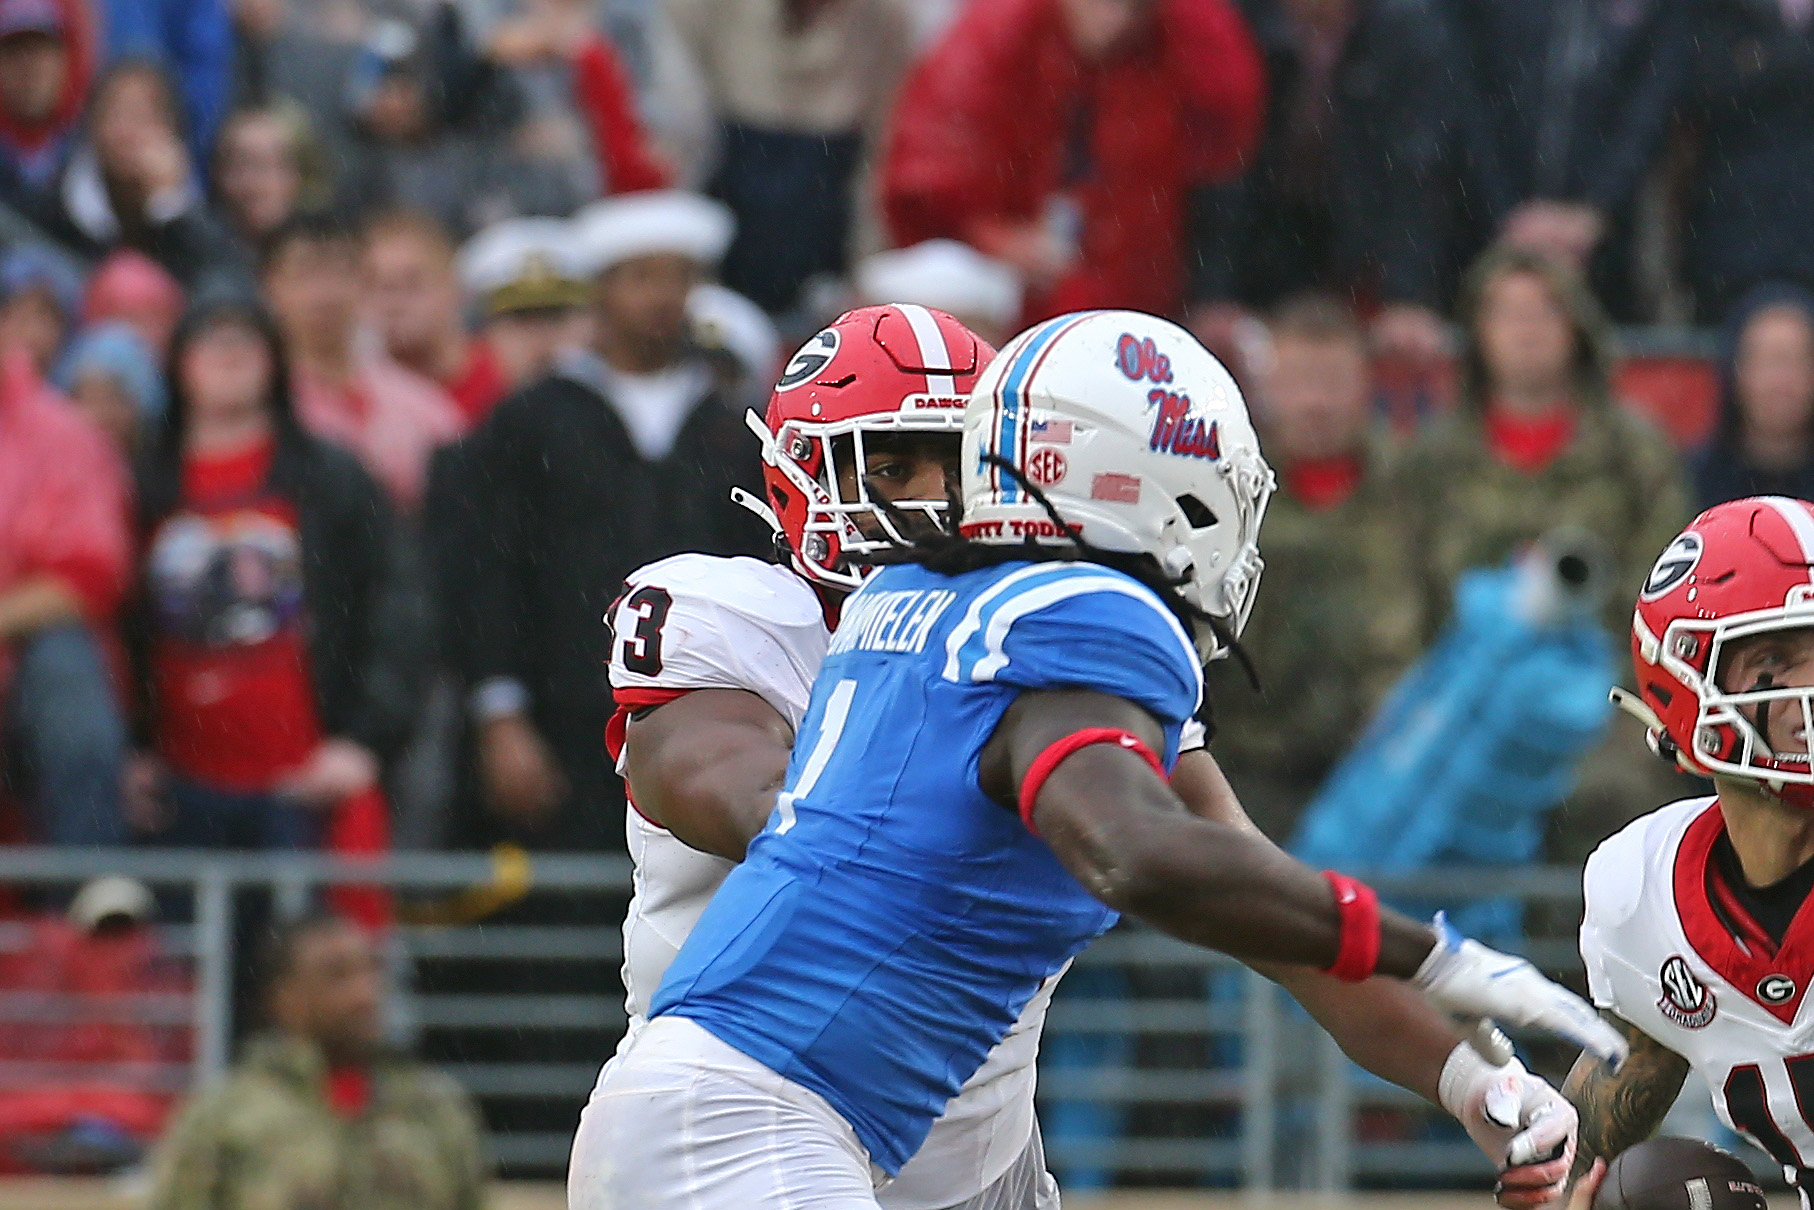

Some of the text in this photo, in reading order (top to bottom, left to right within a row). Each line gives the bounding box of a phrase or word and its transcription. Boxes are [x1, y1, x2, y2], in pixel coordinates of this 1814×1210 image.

[1115, 333, 1173, 383] Ole
[1148, 389, 1220, 461] Miss
[1030, 449, 1064, 485] SEC
[775, 678, 858, 835] 1
